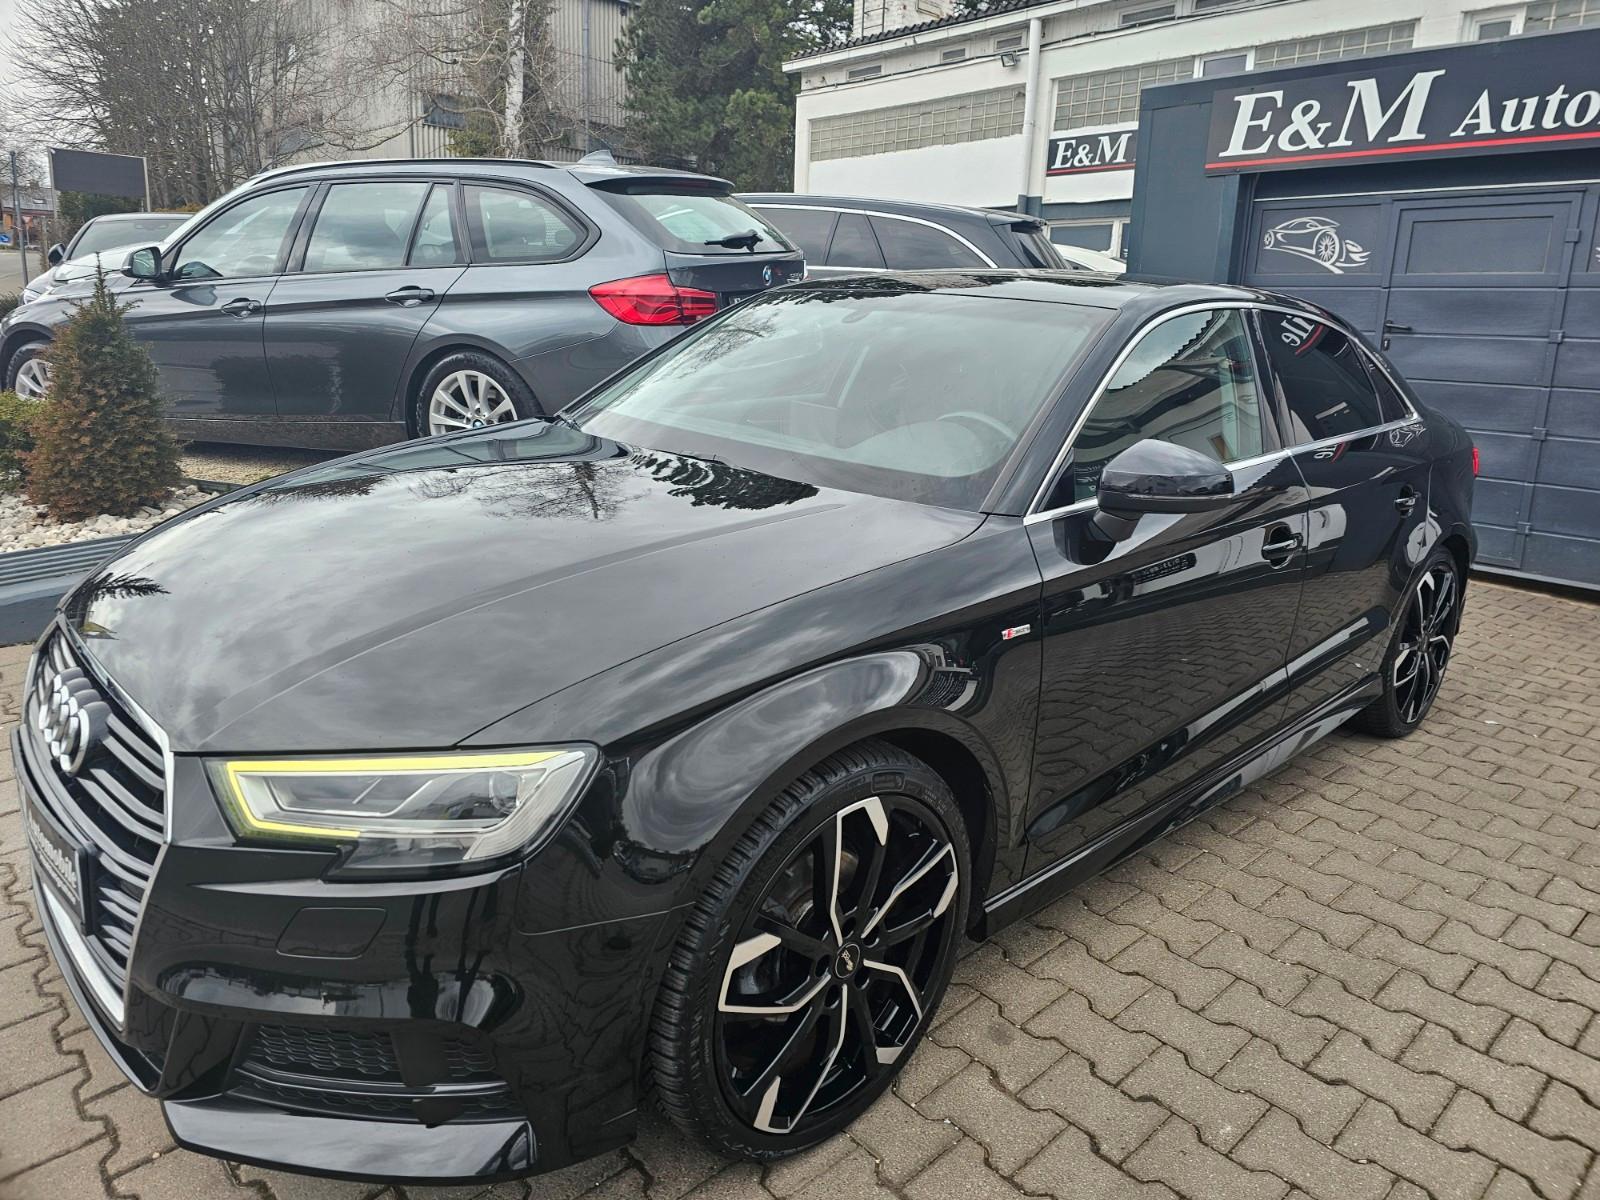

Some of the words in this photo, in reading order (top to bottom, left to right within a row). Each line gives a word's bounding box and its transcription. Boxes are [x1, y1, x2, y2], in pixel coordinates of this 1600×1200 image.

[1218, 69, 1446, 157] E&M
[1449, 84, 1600, 137] Auto
[1050, 133, 1133, 169] E&M
